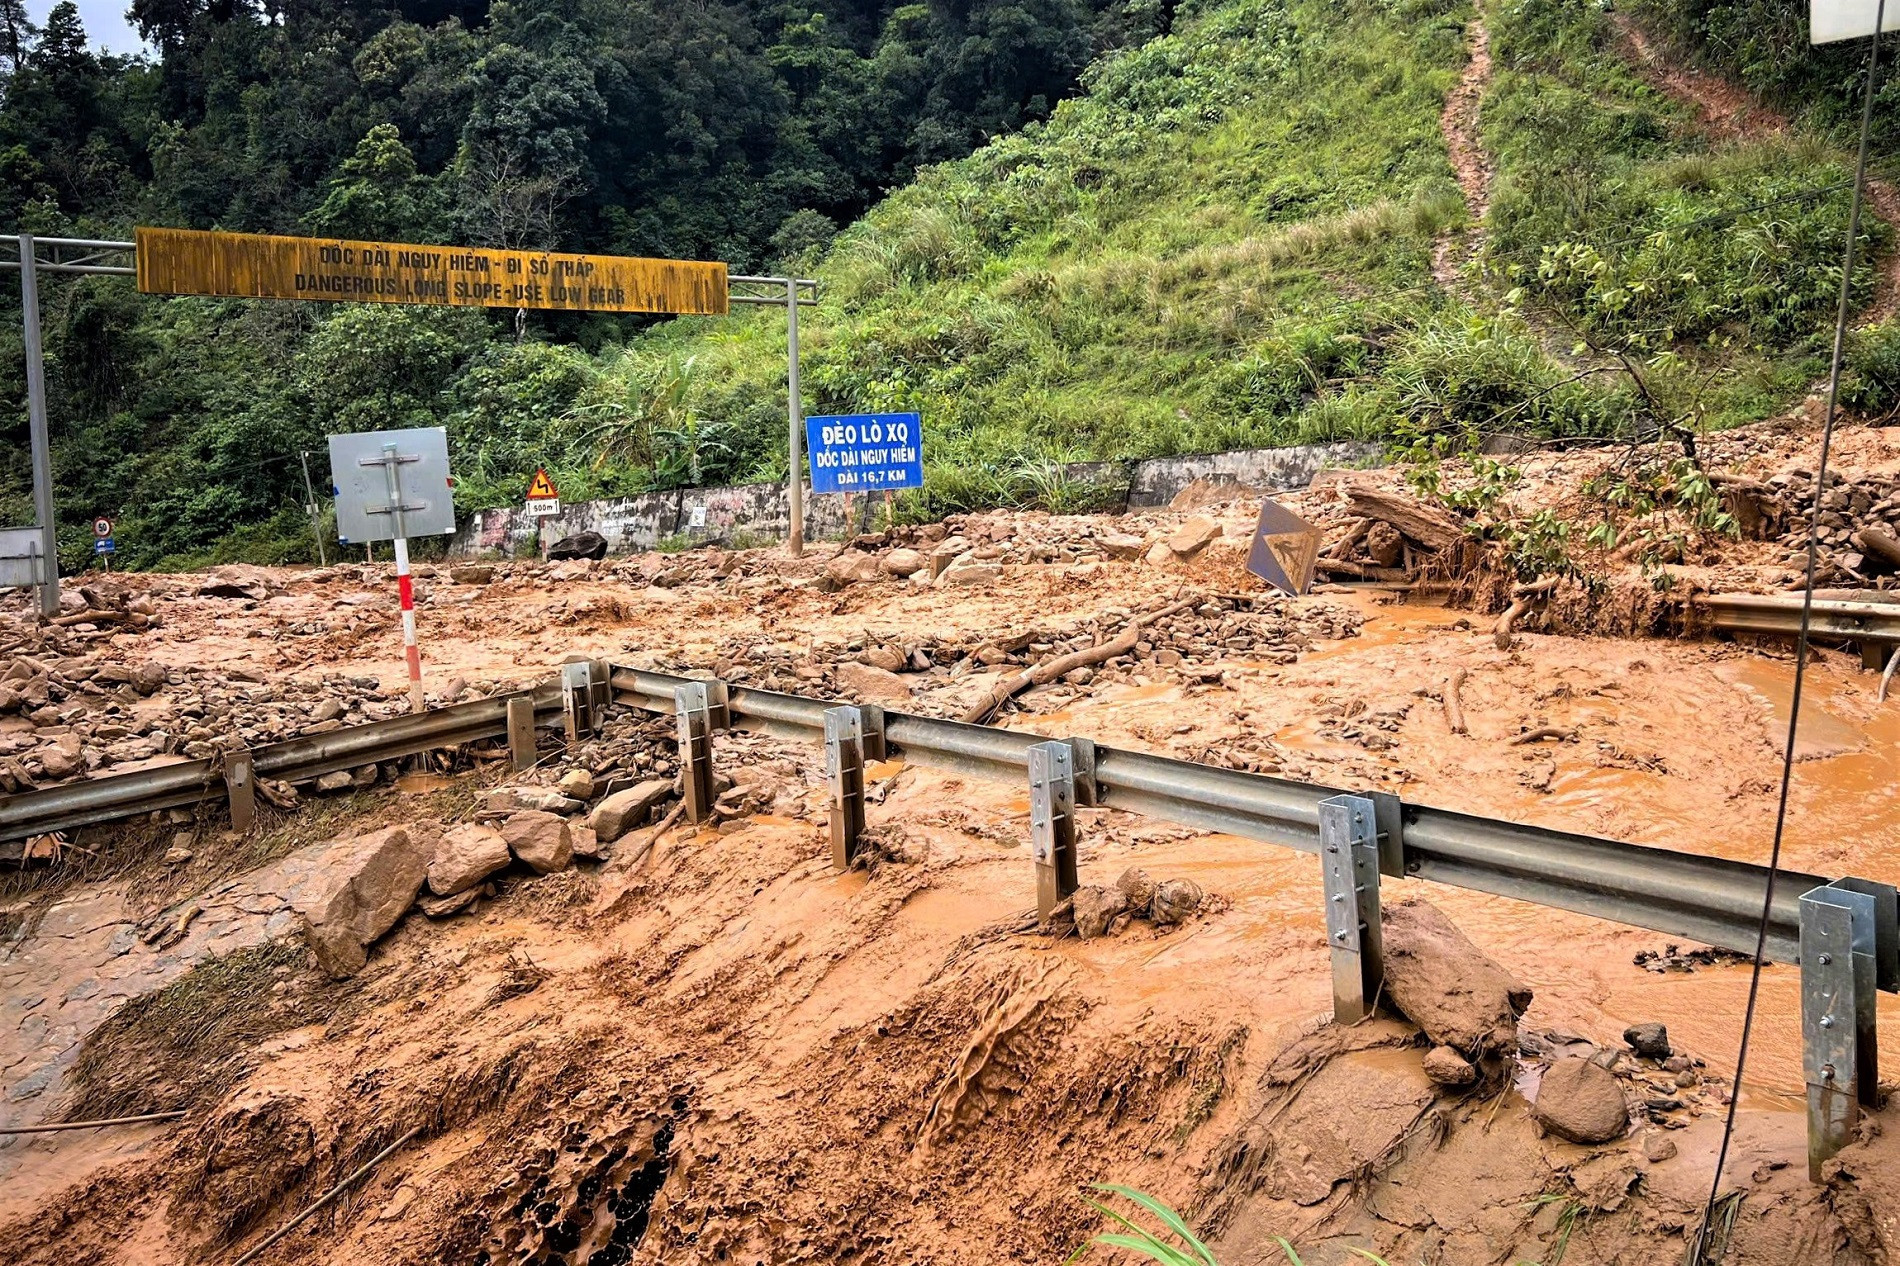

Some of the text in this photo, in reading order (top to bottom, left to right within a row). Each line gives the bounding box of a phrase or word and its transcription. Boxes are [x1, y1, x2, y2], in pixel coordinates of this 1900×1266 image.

[362, 245, 391, 267] DÀI
[397, 251, 442, 270] NGUY
[507, 257, 522, 274] ĐI
[529, 253, 549, 275] SỐ
[554, 255, 594, 277] THẤP
[294, 273, 397, 295] DANGEROUS
[405, 279, 446, 298] LONG
[550, 286, 580, 303] LOW
[588, 288, 625, 304] GEAR
[822, 420, 857, 445] ĐÈO
[861, 419, 882, 443] LÒ
[816, 445, 839, 468] DỐC
[841, 446, 858, 466] DÀI
[860, 448, 888, 465] NGUY
[837, 469, 906, 484] DÀI 16,7 KM
[533, 504, 553, 512] 500m
[98, 523, 107, 532] 50
